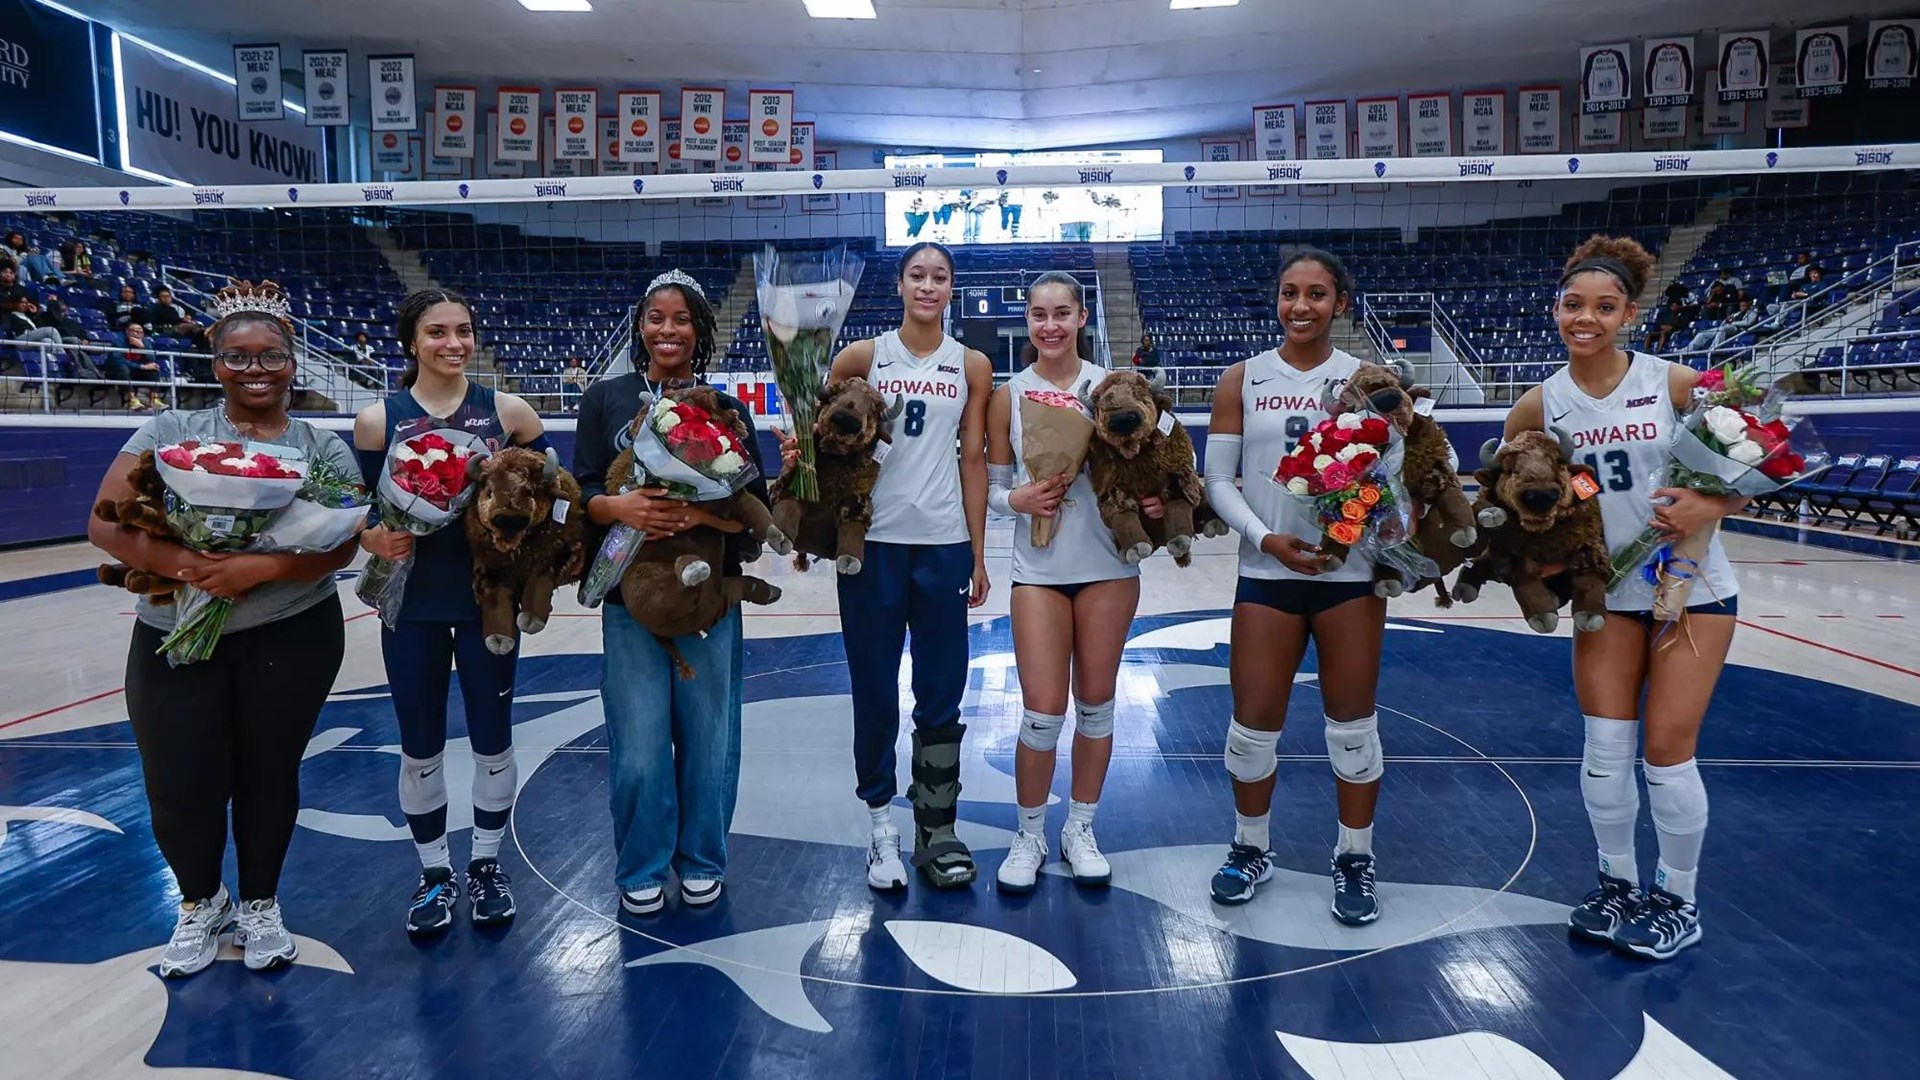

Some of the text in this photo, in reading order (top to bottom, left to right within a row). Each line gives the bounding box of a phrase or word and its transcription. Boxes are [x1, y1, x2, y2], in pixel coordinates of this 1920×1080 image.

[240, 50, 274, 62] 2021-22
[247, 62, 270, 72] MEAC
[309, 56, 342, 68] 2021-22
[381, 62, 402, 72] 2022
[315, 68, 337, 78] MEAC
[382, 73, 403, 83] NCAA
[510, 94, 528, 104] 2001
[561, 94, 591, 103] 2001-02
[694, 94, 712, 103] 2012
[762, 96, 780, 106] 2013
[1650, 96, 1690, 106] 1993-1997
[1722, 90, 1764, 102] 1991-1994
[446, 102, 465, 111] NCAA
[632, 97, 648, 106] 2011
[1420, 100, 1438, 109] 2019
[508, 105, 529, 114] MEAC
[566, 104, 586, 113] MEAC
[631, 107, 648, 116] WNIT
[694, 104, 712, 114] WNIT
[764, 106, 778, 115] CBI
[1316, 106, 1336, 114] 2022
[1369, 104, 1386, 114] 2021
[1474, 107, 1494, 116] NCAA
[1529, 103, 1550, 112] MEAC
[1586, 102, 1626, 112] 2014-2017
[1264, 111, 1284, 120] 2024
[1368, 114, 1388, 122] MEAC
[1419, 109, 1440, 118] MEAC
[1264, 120, 1285, 130] MEAC
[1316, 116, 1336, 124] MEAC
[136, 86, 318, 184] HU! YOU KNOW!
[724, 134, 744, 142] MEAC
[1854, 150, 1894, 166] BISON
[1458, 162, 1494, 176] BISON
[1654, 157, 1690, 172] BISON
[1078, 170, 1113, 184] BISON
[1266, 166, 1302, 180] BISON
[710, 178, 744, 192] BISON
[892, 174, 927, 188] BISON
[534, 182, 567, 197] BISON
[192, 190, 224, 205] BISON
[362, 188, 394, 202] BISON
[25, 194, 56, 207] BISON
[968, 289, 988, 297] HOME
[979, 300, 988, 313] 0
[878, 380, 958, 399] HOWARD
[904, 400, 926, 437] 8
[1584, 450, 1634, 494] 13
